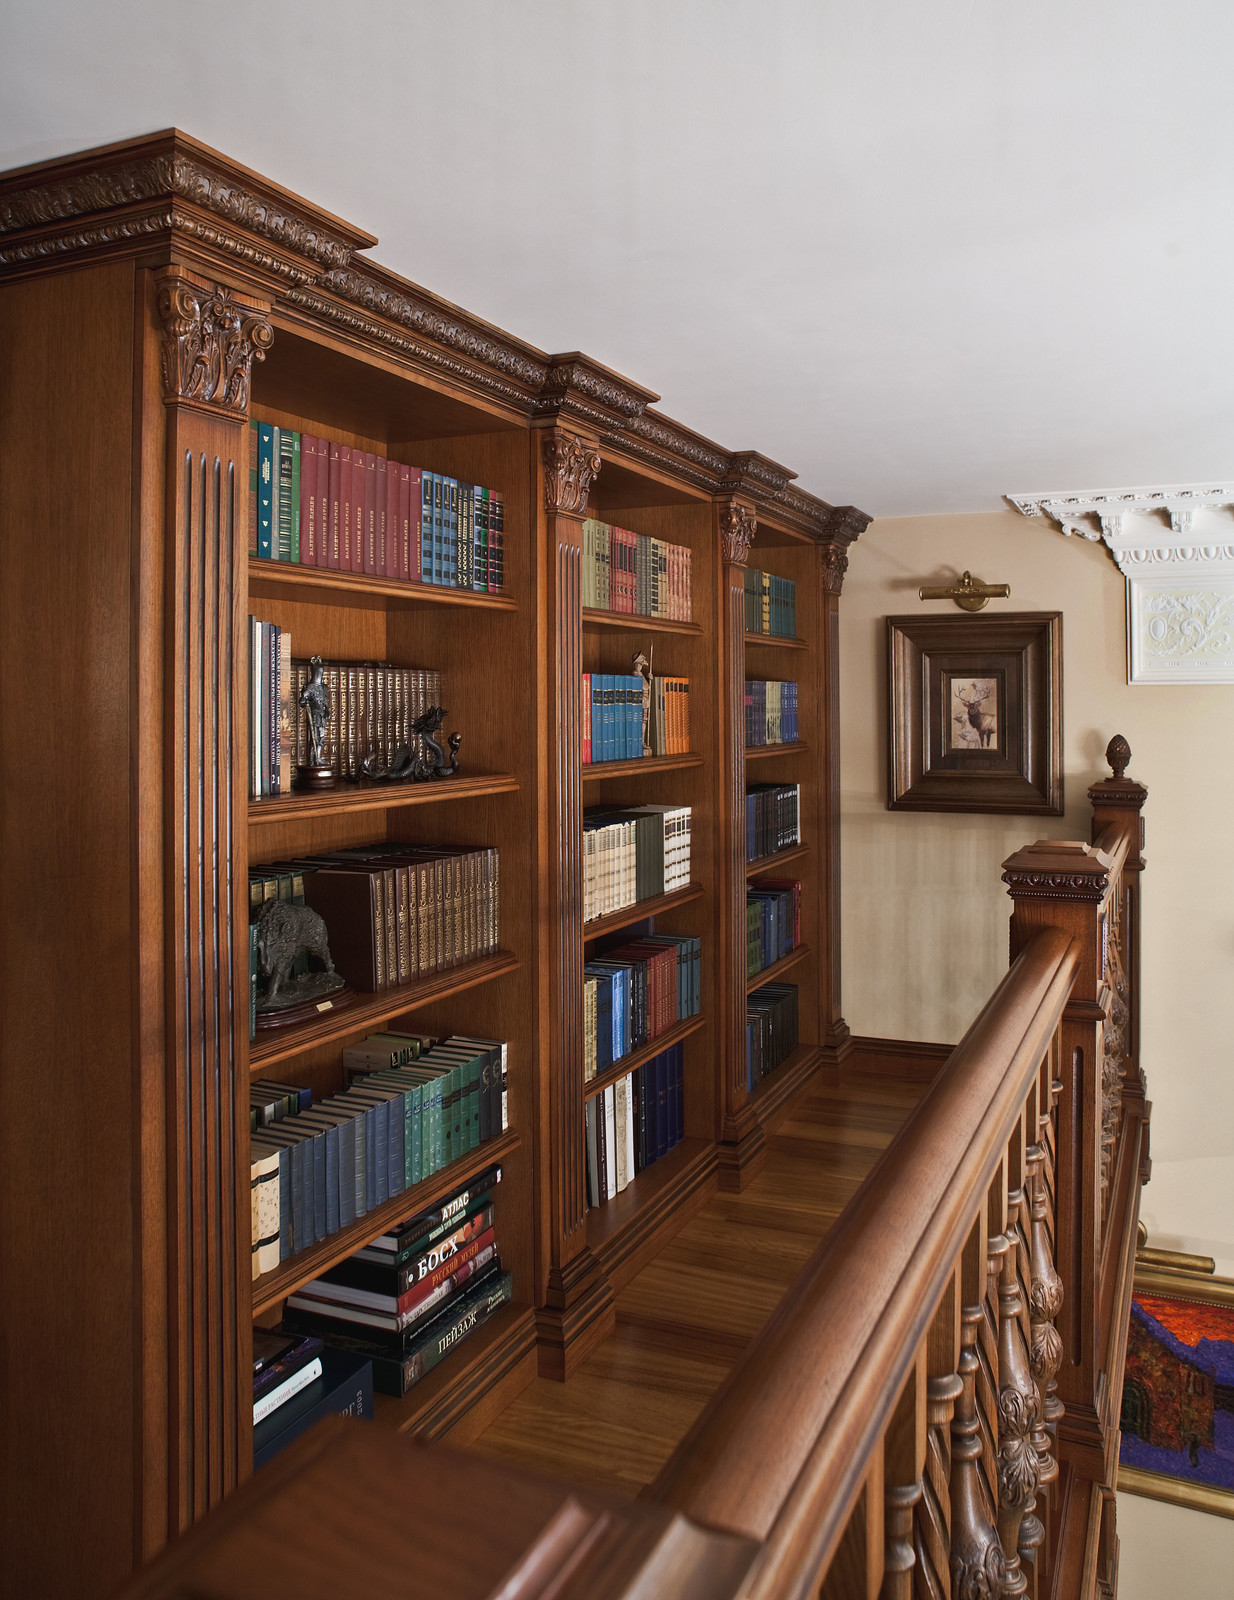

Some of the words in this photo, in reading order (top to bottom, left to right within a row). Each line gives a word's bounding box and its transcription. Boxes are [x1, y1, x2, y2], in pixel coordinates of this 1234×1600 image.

[441, 1193, 469, 1221] АТЛАС
[417, 1235, 458, 1280] БОСХ
[431, 1258, 458, 1286] РУССКИЙ
[461, 1242, 479, 1264] МУЗЕЙ
[438, 1311, 477, 1354] ПЕЙЗАЖ
